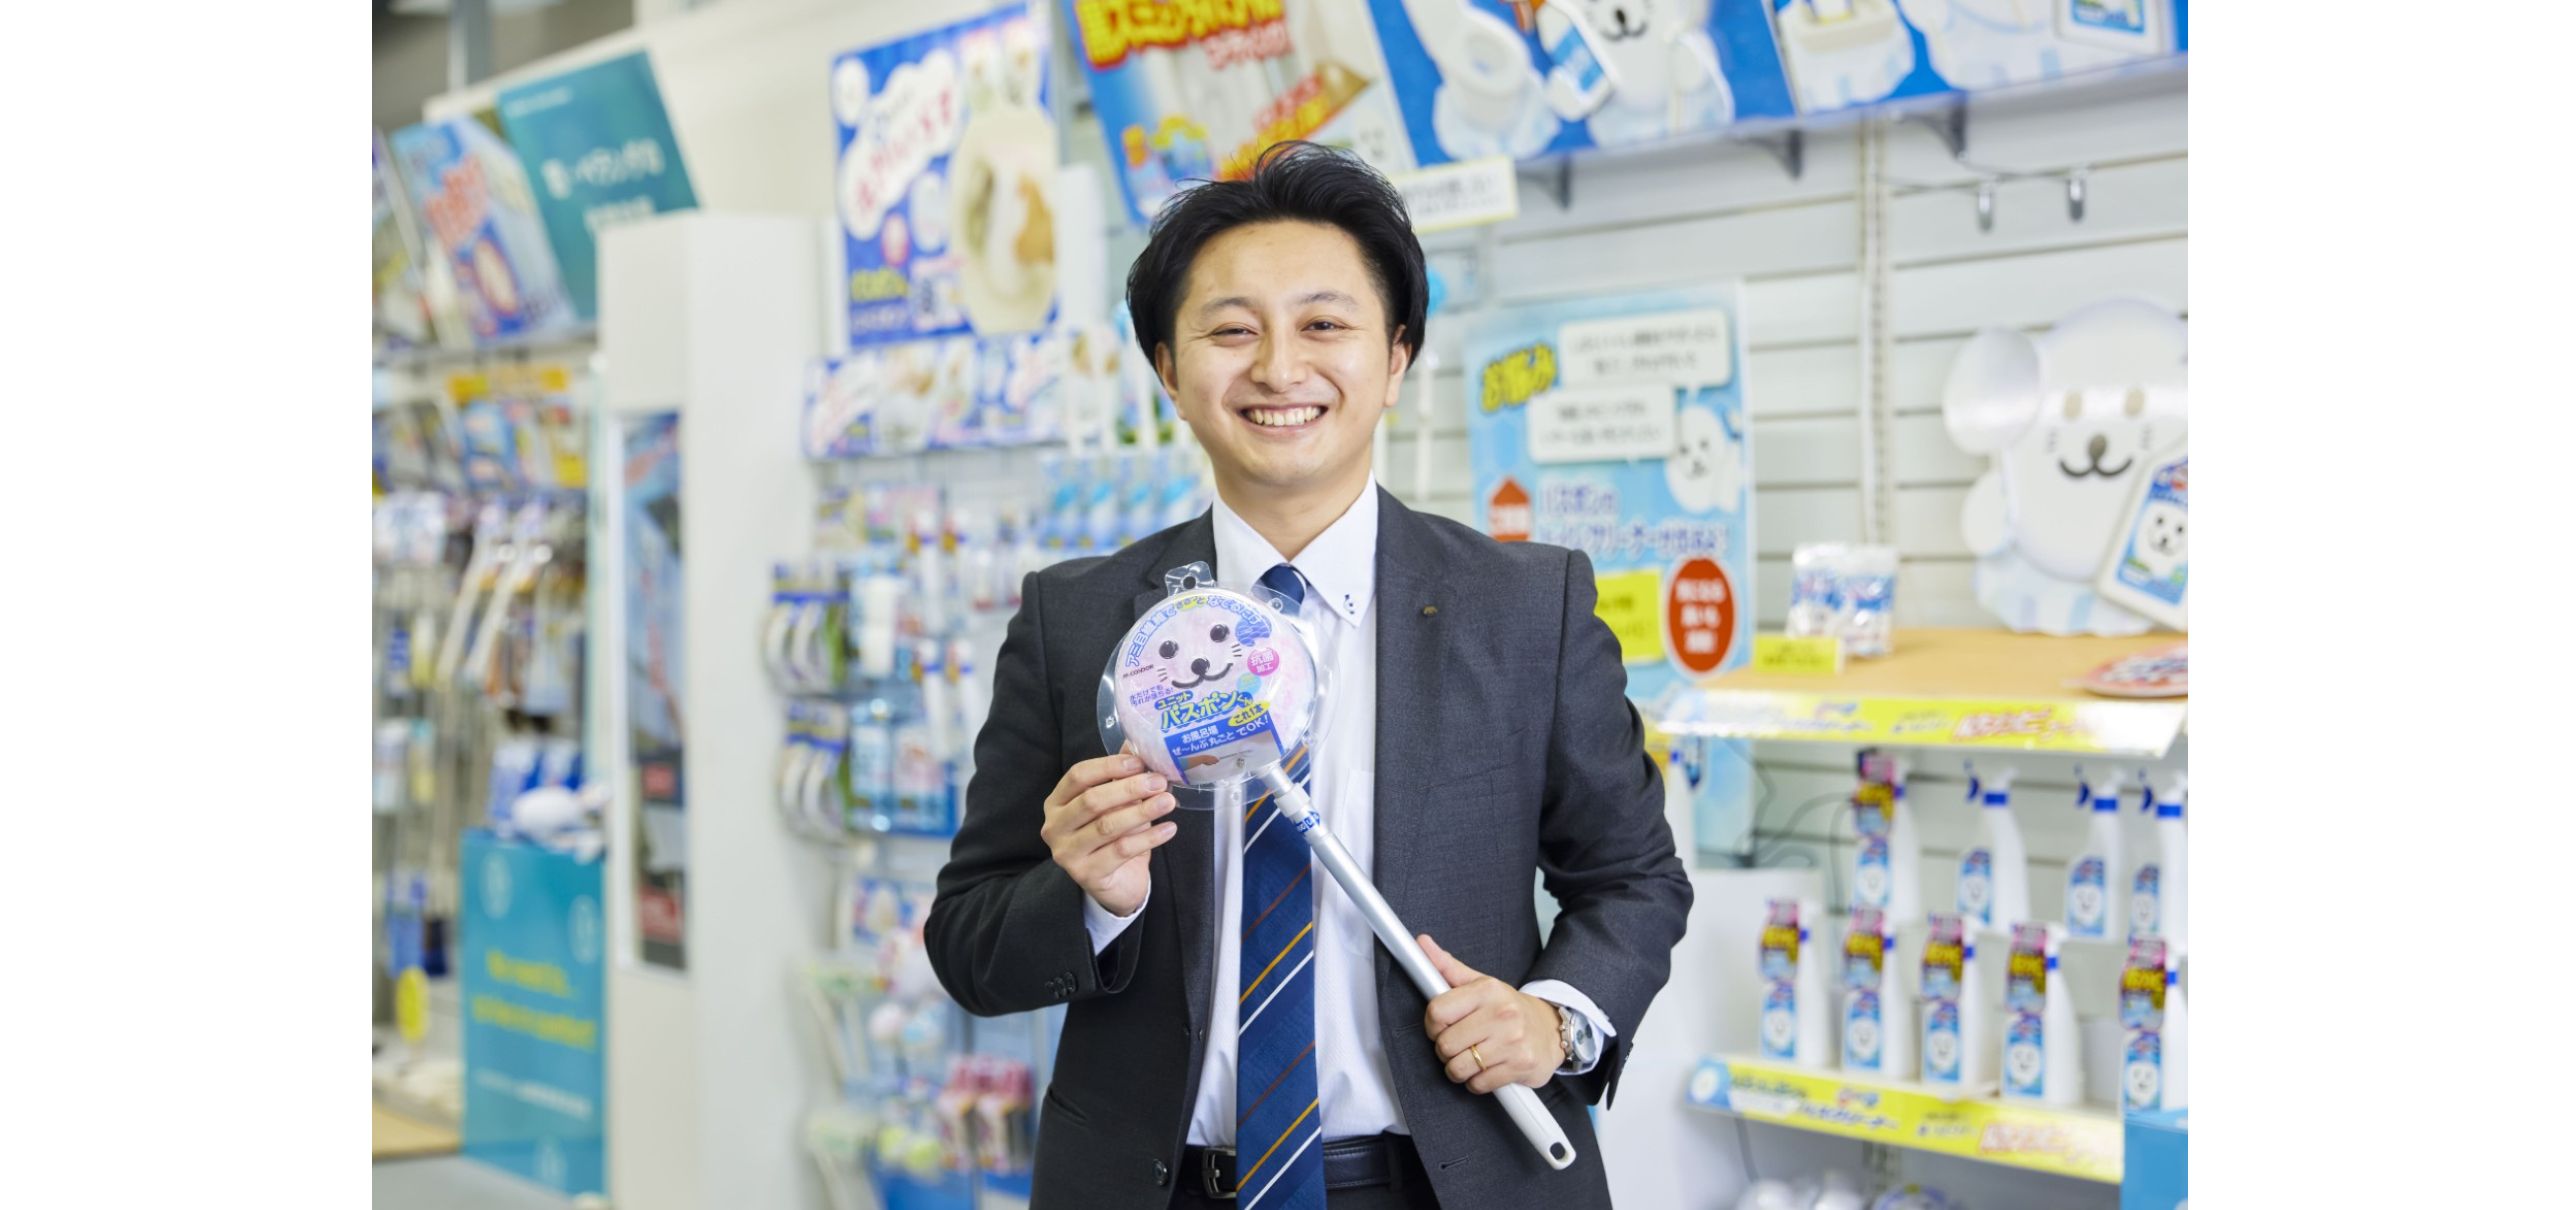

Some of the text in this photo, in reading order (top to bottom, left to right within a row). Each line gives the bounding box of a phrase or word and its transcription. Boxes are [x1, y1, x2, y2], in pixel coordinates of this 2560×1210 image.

[1157, 691, 1192, 709] ユニット
[1181, 725, 1219, 744] お風呂場
